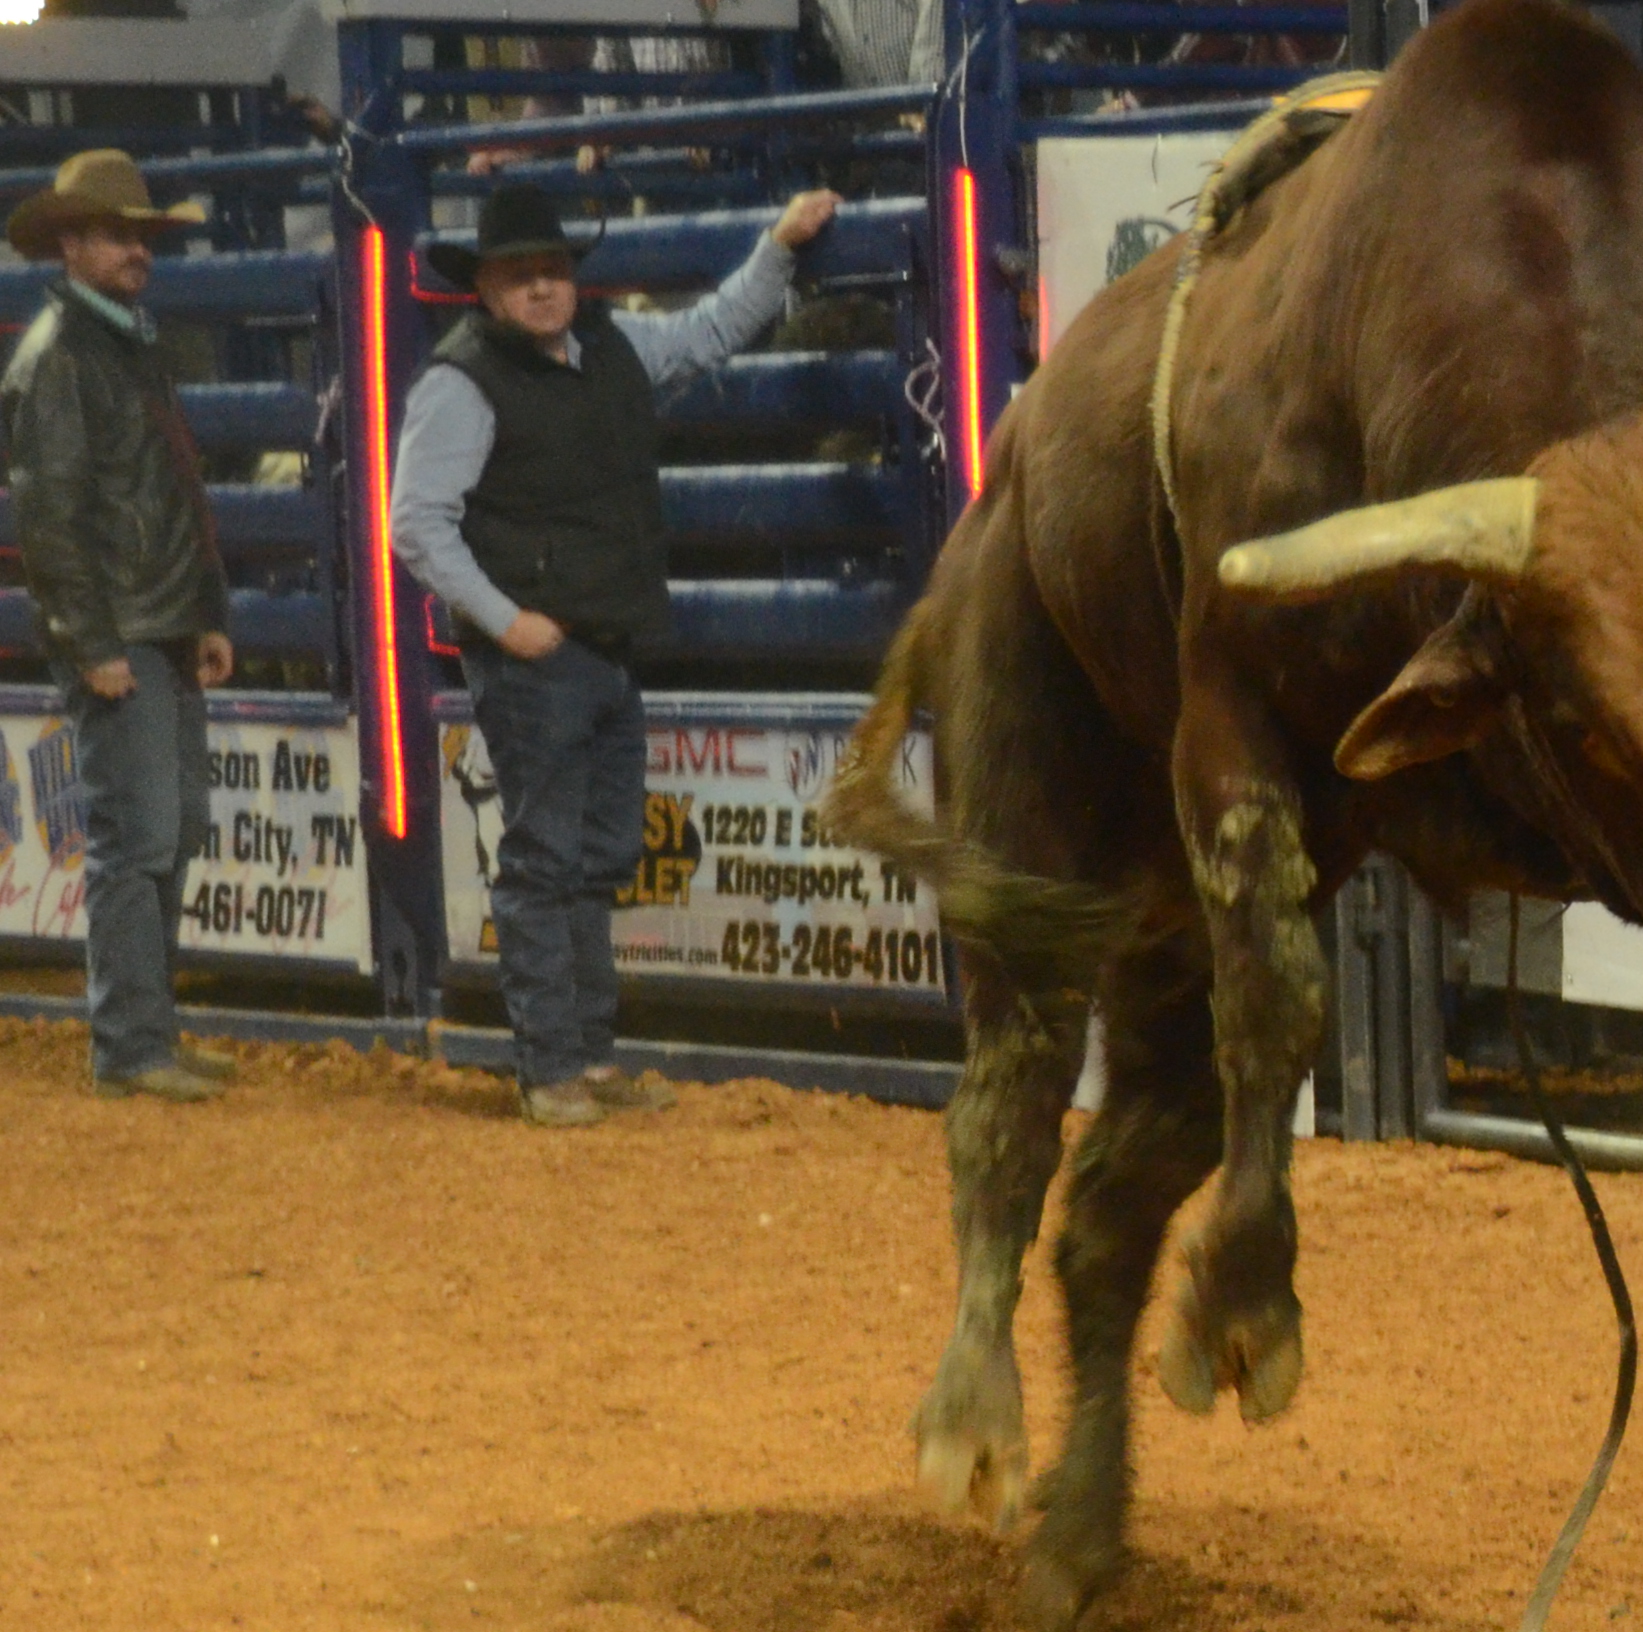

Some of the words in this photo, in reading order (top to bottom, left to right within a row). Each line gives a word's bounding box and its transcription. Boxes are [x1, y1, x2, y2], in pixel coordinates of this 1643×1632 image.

[272, 739, 331, 793] Ave
[646, 727, 768, 777] GMC
[233, 809, 299, 877] City,
[311, 815, 356, 868] TN
[702, 803, 767, 847] 1220
[775, 808, 793, 848] E
[716, 855, 871, 910] Kingsport,
[880, 861, 917, 904] TN
[721, 920, 939, 985] 423-246-4101
